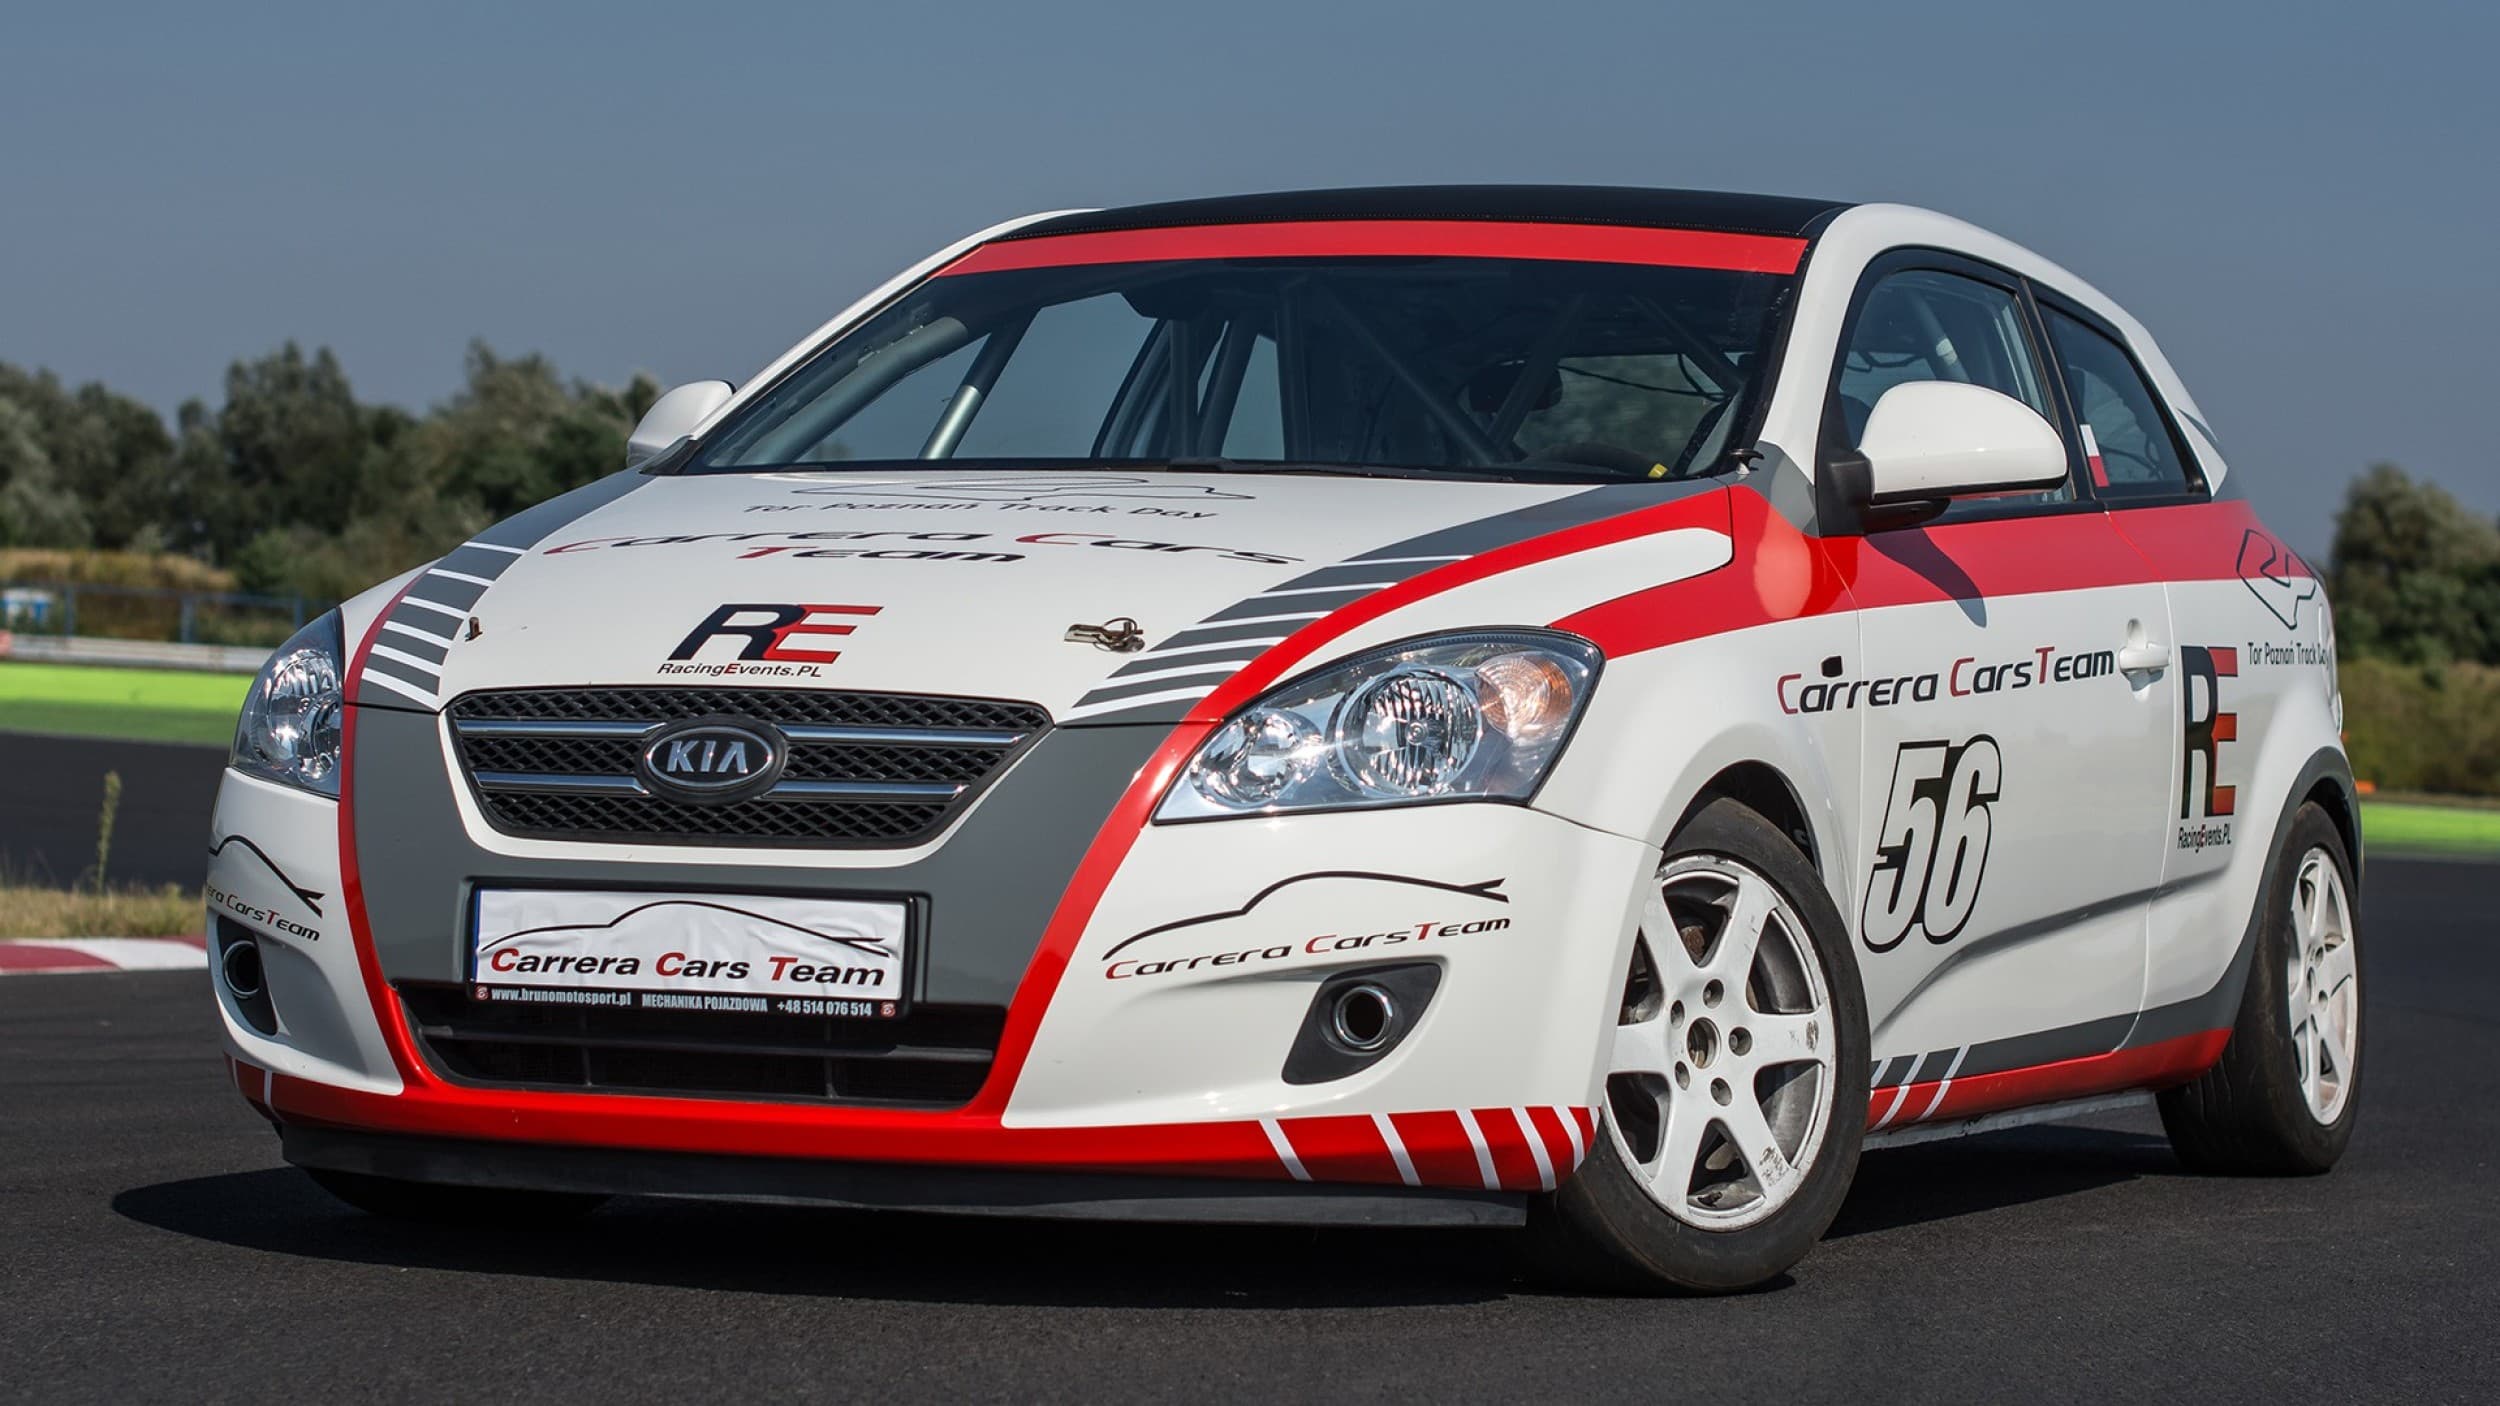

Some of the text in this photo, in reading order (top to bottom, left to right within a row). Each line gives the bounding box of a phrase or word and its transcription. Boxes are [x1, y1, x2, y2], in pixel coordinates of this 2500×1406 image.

[743, 504, 813, 513] Tor
[998, 503, 1118, 514] Track
[1128, 507, 1219, 519] Day
[542, 531, 1305, 565] Carrera Cars
[735, 545, 1027, 563] Team
[667, 603, 884, 664] RE
[2247, 641, 2262, 665] Tor
[2296, 641, 2317, 665] Track
[657, 663, 822, 678] RacingEvents.PL
[1776, 673, 1939, 715] Carrera
[2180, 645, 2238, 820] RE
[666, 740, 749, 774] KIA
[1861, 733, 2002, 954] 56
[2176, 822, 2232, 854] RacingEvents.PL
[491, 947, 886, 987] Carrera Cars Team
[1104, 944, 1293, 981] Carrera
[491, 987, 873, 1017] www.brunomotosport.pl MECHANIKA POJAZDOWA +48 514 076 514
